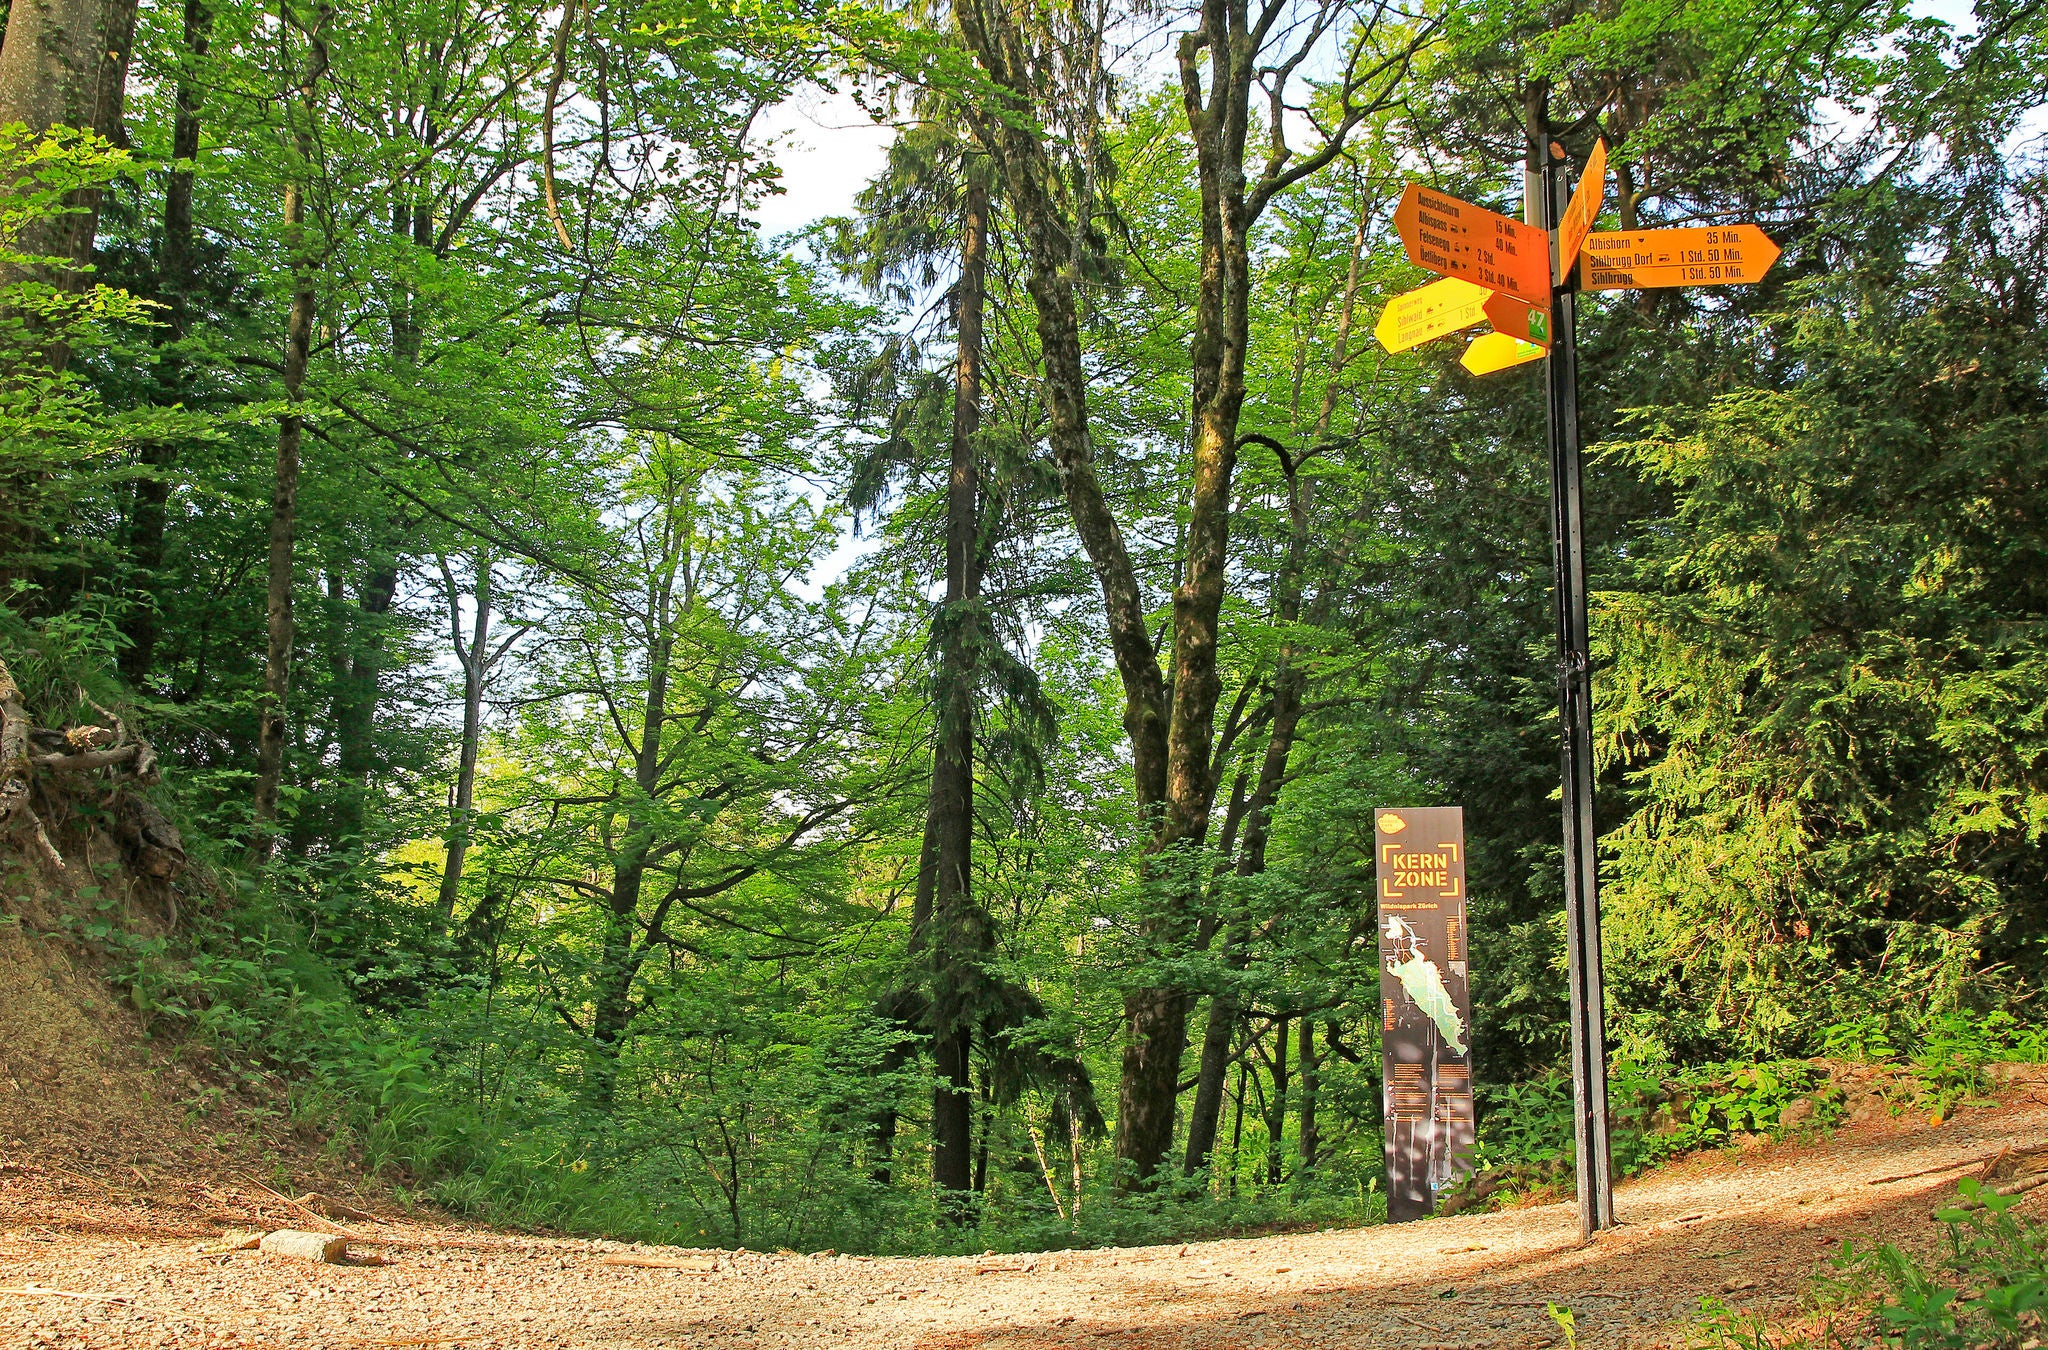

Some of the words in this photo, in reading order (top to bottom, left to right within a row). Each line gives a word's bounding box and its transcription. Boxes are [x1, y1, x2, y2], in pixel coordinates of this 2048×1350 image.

[1418, 192, 1459, 218] Aussichtsturm
[1495, 220, 1503, 234] 15
[1505, 224, 1517, 239] Min.
[1418, 210, 1448, 233] Albispass
[1495, 238, 1504, 252] 40
[1505, 241, 1518, 257] Min.
[1590, 237, 1631, 250] Albishorn
[1706, 231, 1719, 245] 35
[1722, 231, 1742, 244] Min.
[1420, 228, 1450, 253] Felsenegg
[1477, 248, 1482, 262] 2
[1484, 250, 1496, 266] Std.
[1590, 254, 1632, 268] Sihlbrugg
[1634, 252, 1653, 266] Dorf
[1688, 250, 1706, 263] Std.
[1708, 248, 1720, 262] 50
[1723, 248, 1743, 261] Min.
[1478, 267, 1483, 280] 3
[1484, 269, 1496, 285] Std.
[1497, 274, 1506, 288] 40
[1507, 277, 1520, 292] Min.
[1591, 272, 1633, 285] Sihlbrugg
[1689, 267, 1707, 280] Std.
[1709, 265, 1721, 279] 50
[1725, 265, 1745, 278] Min.
[1527, 308, 1545, 327] 47
[1393, 853, 1447, 870] KERN
[1393, 870, 1448, 887] ZONE
[1379, 903, 1417, 911] Wildnispark
[1417, 902, 1438, 910] Zürich
